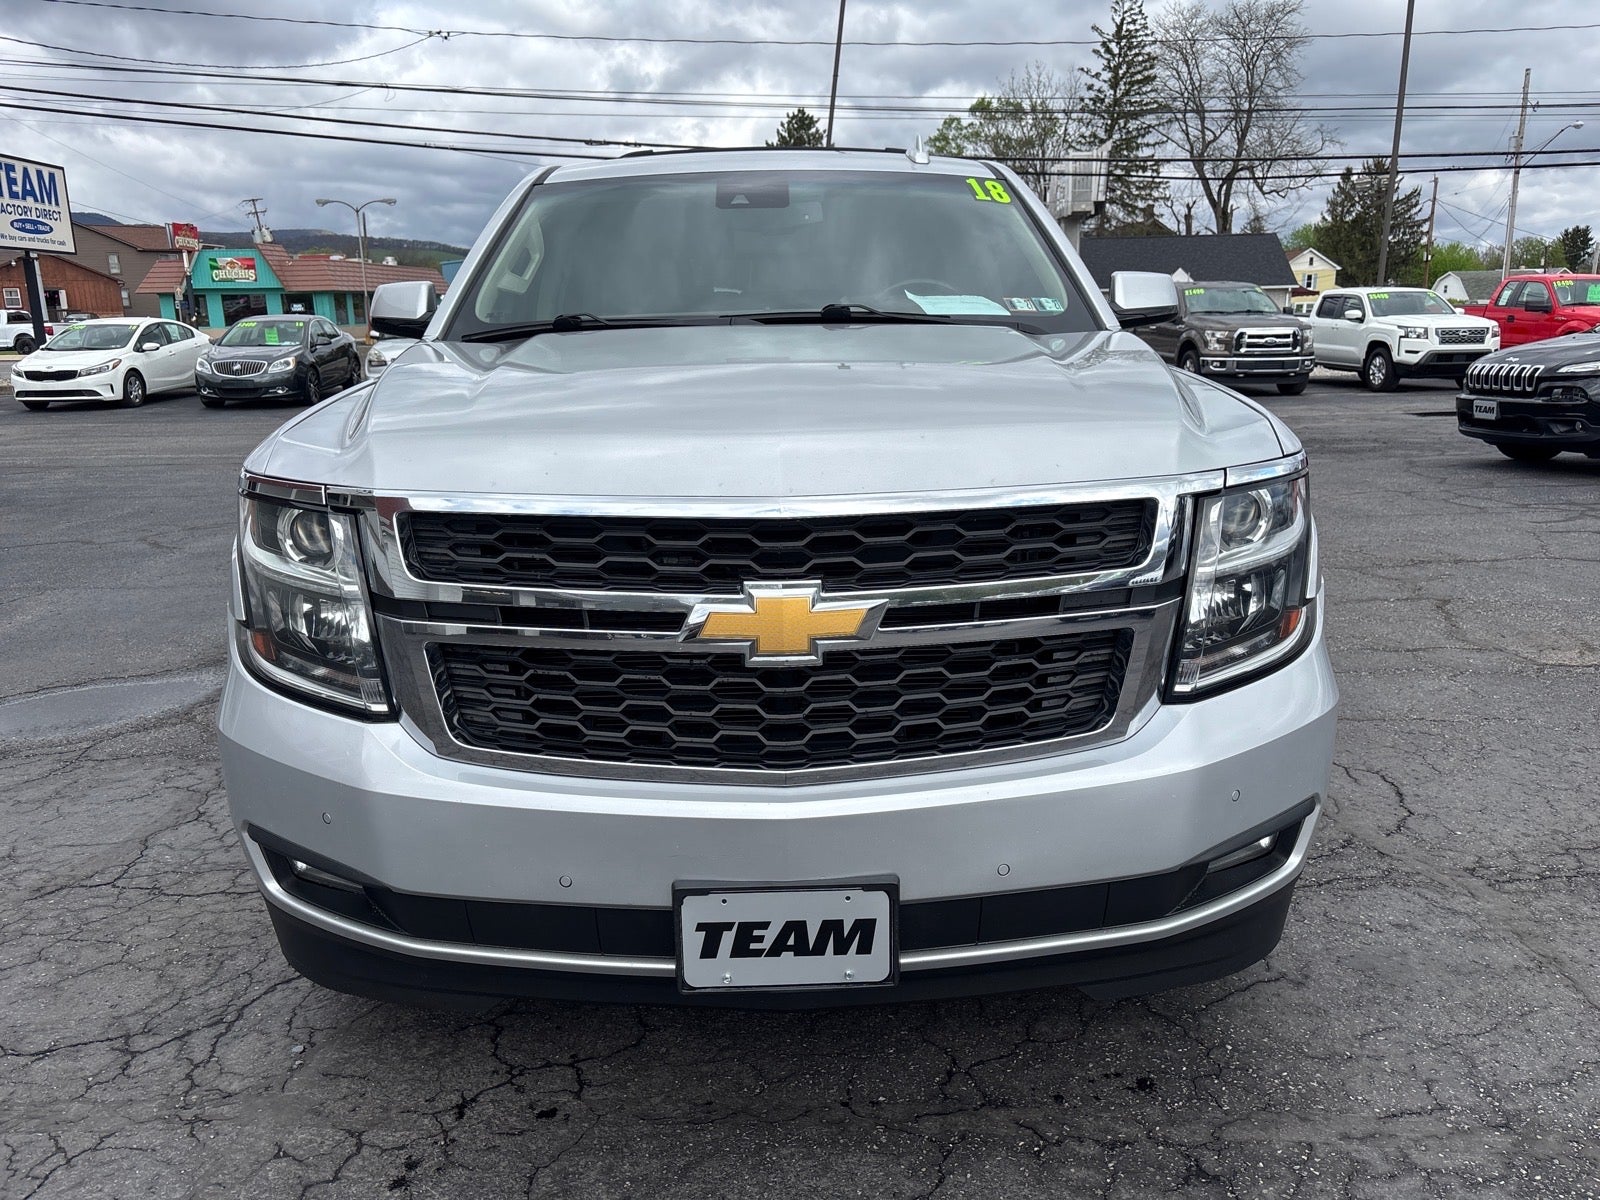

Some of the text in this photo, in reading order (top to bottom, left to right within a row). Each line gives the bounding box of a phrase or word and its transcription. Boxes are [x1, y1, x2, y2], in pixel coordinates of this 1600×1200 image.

[966, 178, 1012, 204] 18
[0, 202, 62, 222] ACTORY DIRECT
[13, 221, 51, 232] BUY SELL TRADE
[8, 234, 17, 242] buy
[36, 236, 50, 244] trucks
[57, 239, 67, 247] cash
[212, 269, 256, 281] CHUCHIS
[1475, 405, 1496, 415] TEAM
[695, 918, 877, 960] TEAM
